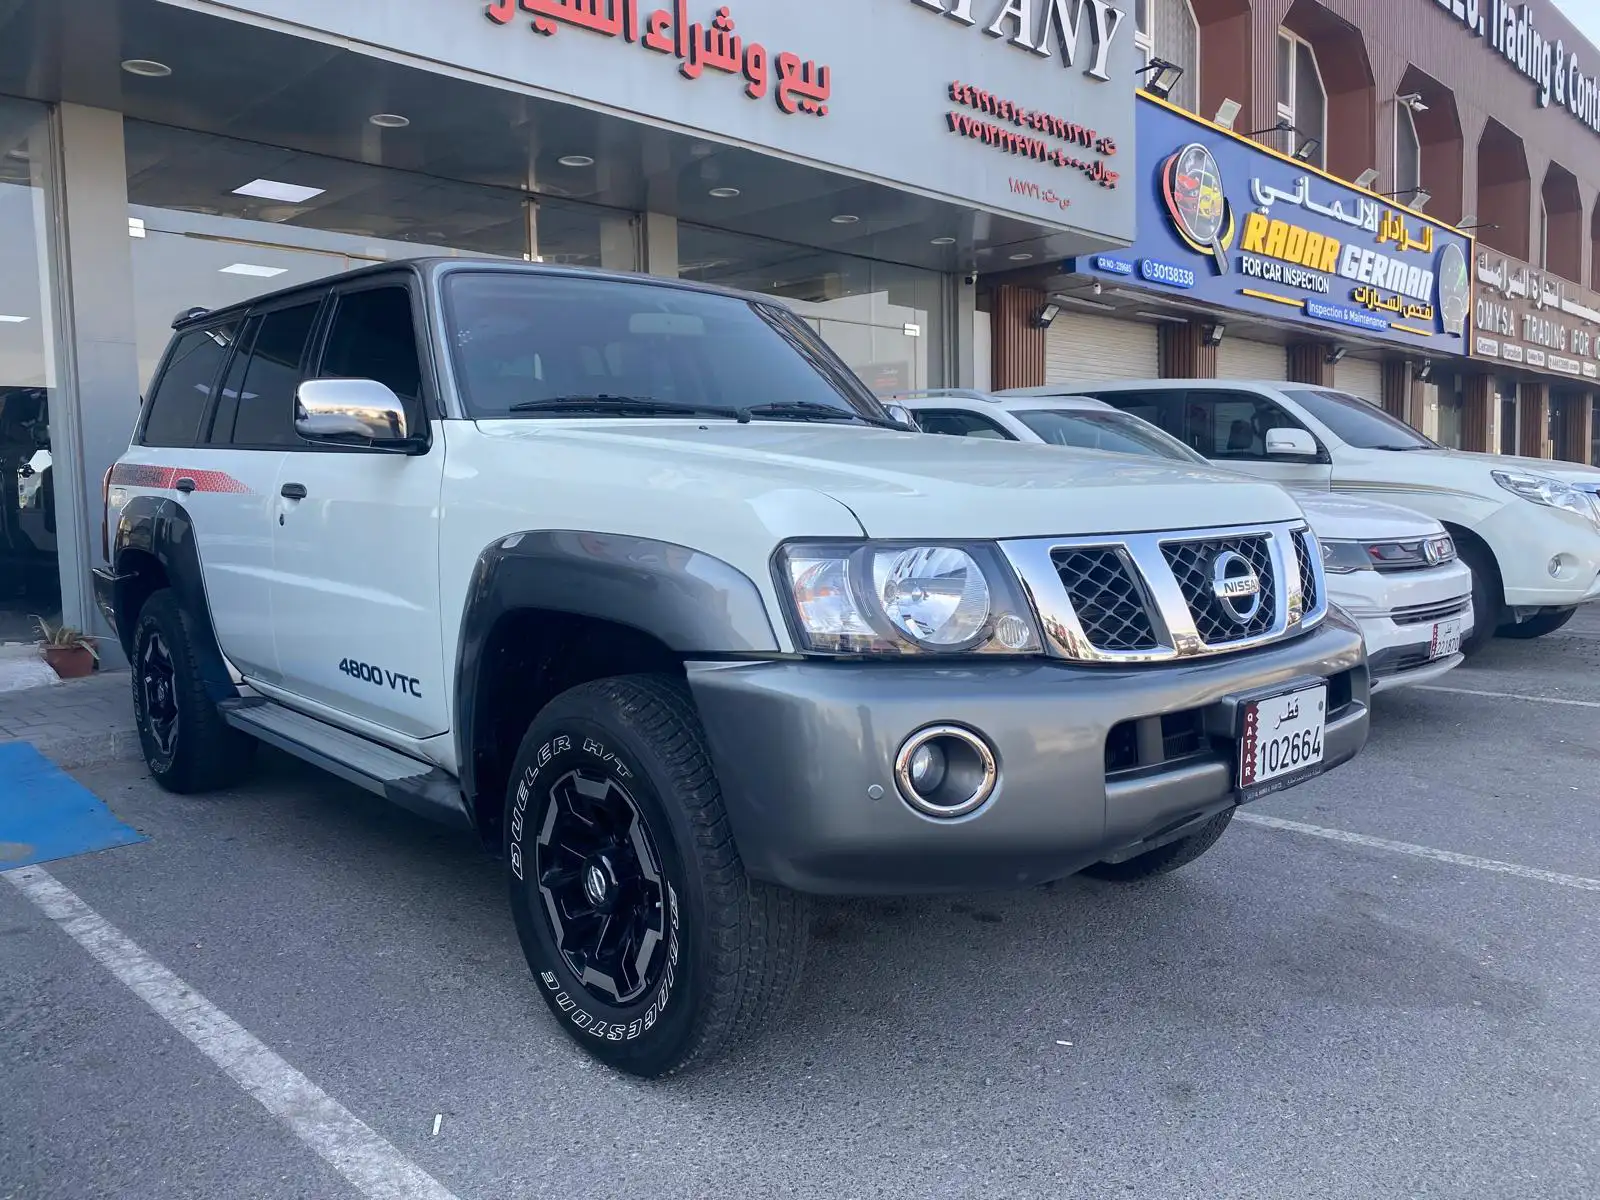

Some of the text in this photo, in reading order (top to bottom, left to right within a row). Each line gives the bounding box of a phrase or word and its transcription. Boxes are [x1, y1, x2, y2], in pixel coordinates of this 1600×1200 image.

[911, 0, 1127, 82] ANY
[776, 51, 831, 115] بيع
[1555, 40, 1566, 106] &
[1153, 263, 1194, 286] 30138338
[1241, 211, 1434, 302] RADAR GERMAN
[1242, 256, 1330, 294] FOR CAR INSPECTION
[1309, 300, 1387, 329] Inspection & Maintenance
[1354, 285, 1403, 313] السيارات
[1477, 298, 1516, 337] OMYSA
[1523, 313, 1566, 350] TRADING
[1573, 329, 1590, 356] FOR
[339, 658, 422, 698] 4800 VTC
[1273, 696, 1299, 730] قطر
[1244, 713, 1254, 777] QATAR
[1260, 725, 1321, 776] 102664
[510, 735, 634, 881] DUELER H/T
[541, 880, 679, 1041] BRIDGESTONE
